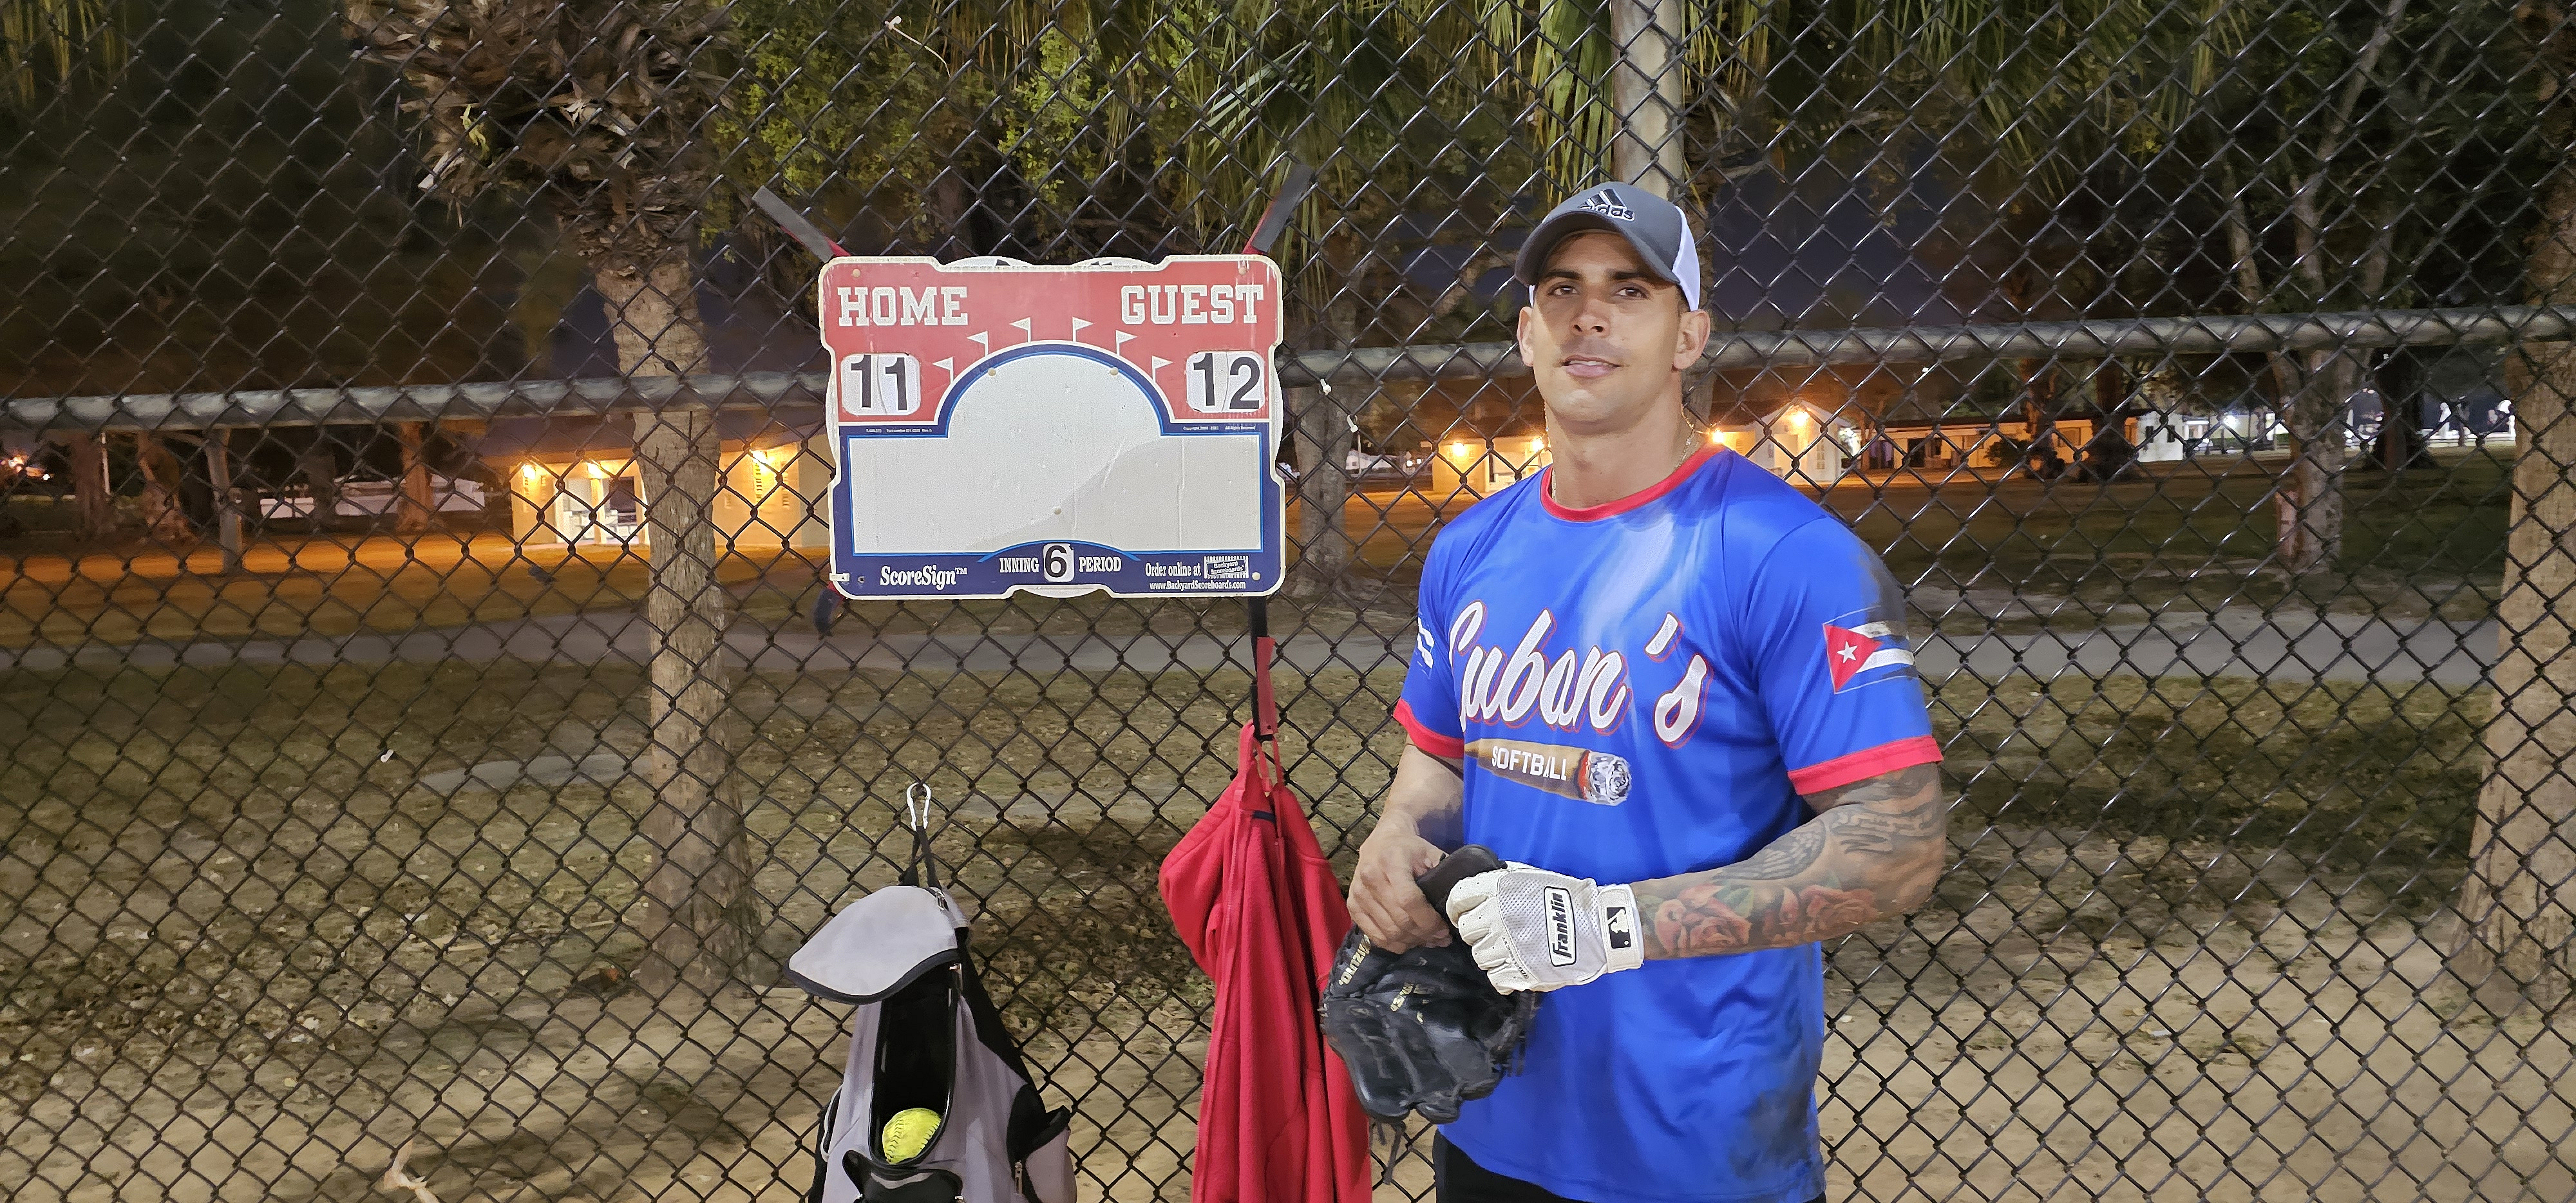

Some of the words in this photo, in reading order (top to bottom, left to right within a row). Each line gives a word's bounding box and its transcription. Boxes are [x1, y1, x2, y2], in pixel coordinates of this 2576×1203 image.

[837, 286, 969, 327] HOME
[1121, 284, 1264, 325] GUEST
[851, 354, 907, 410] 11
[1193, 352, 1260, 410] 12
[999, 557, 1040, 573] INNING
[1045, 545, 1067, 578] 6
[1079, 556, 1122, 573] PERIOD
[1145, 562, 1167, 577] Order
[1168, 561, 1192, 576] online
[1193, 562, 1202, 576] at
[1213, 560, 1239, 569] Backyard
[1149, 580, 1246, 592] www.BackyardScoreboards.com
[1550, 892, 1573, 958] Franklin
